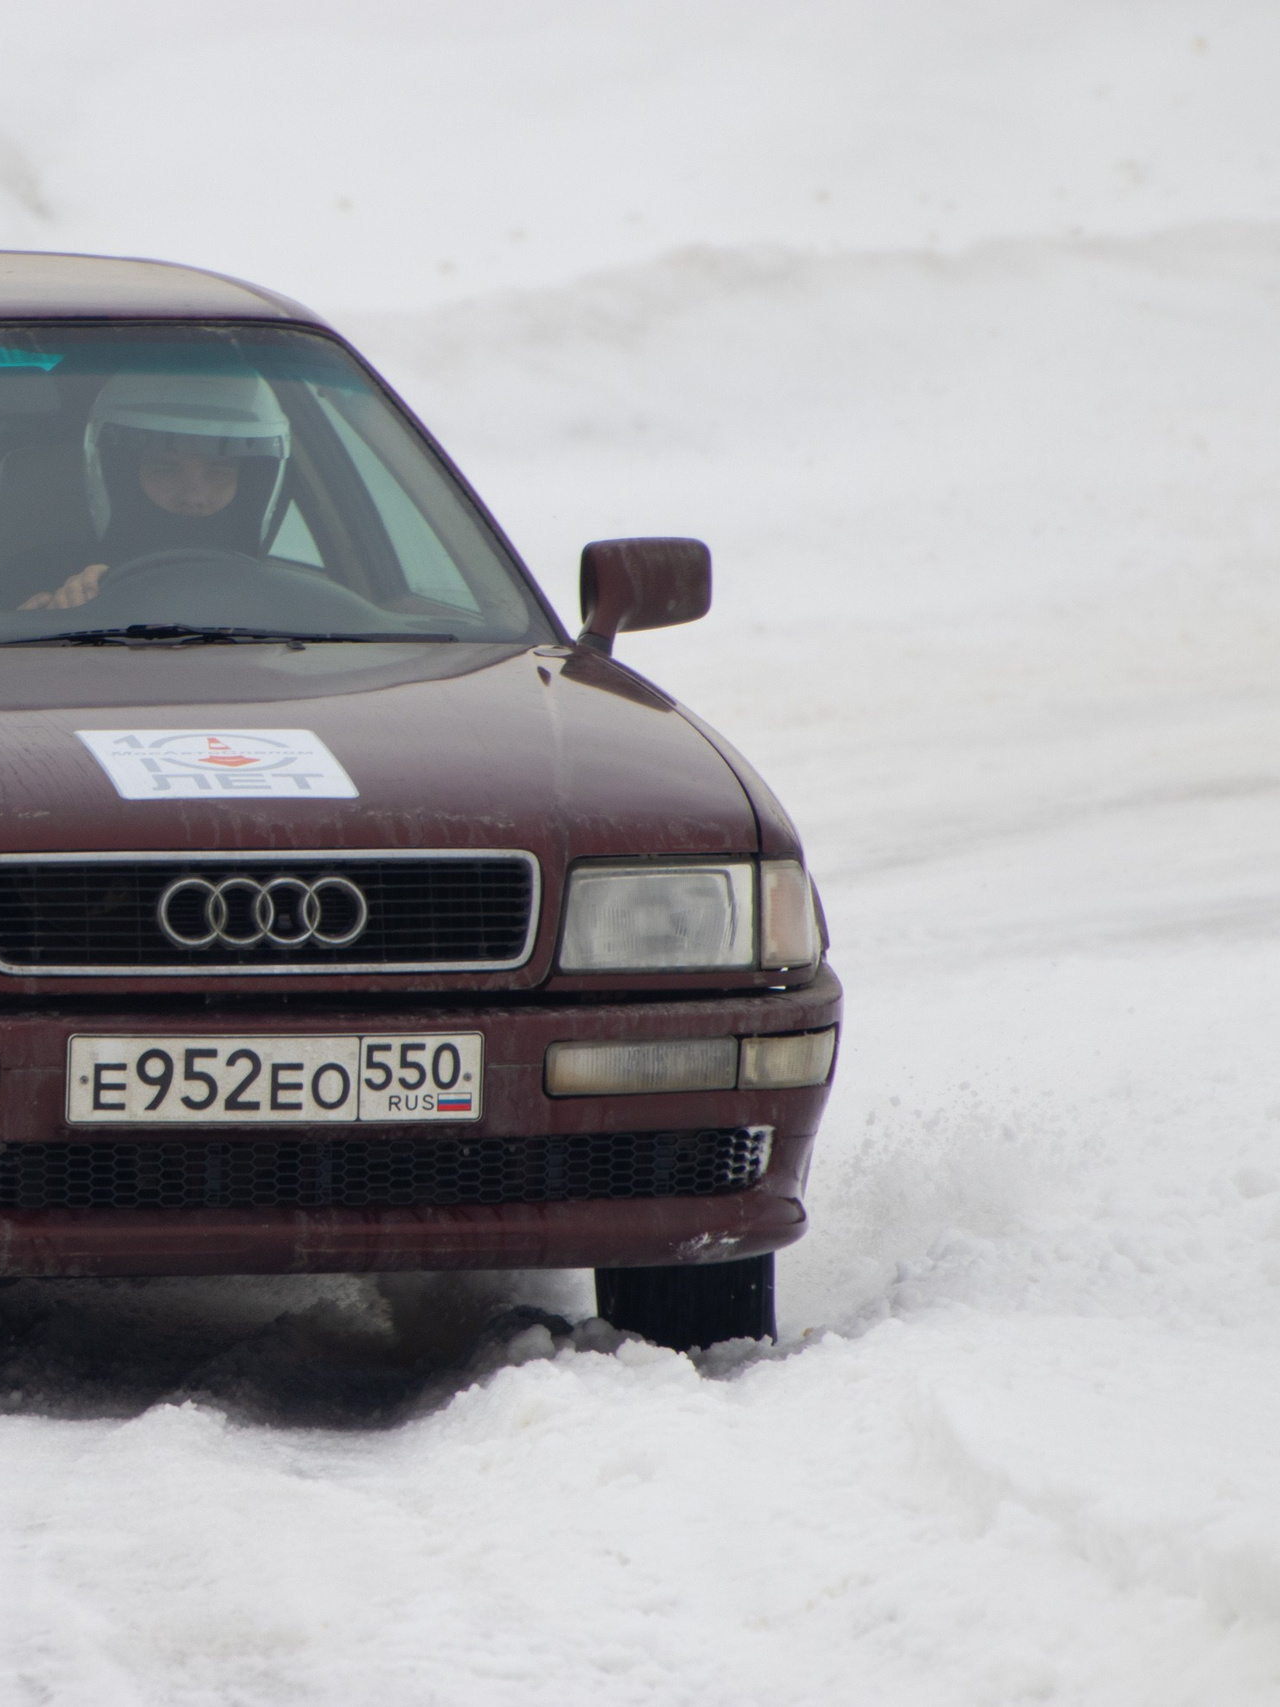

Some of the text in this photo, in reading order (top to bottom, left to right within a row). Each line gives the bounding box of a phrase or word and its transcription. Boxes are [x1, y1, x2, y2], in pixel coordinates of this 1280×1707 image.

[152, 773, 324, 791] ЛЕТ
[364, 1043, 461, 1090] 550
[388, 1094, 435, 1111] RUS
